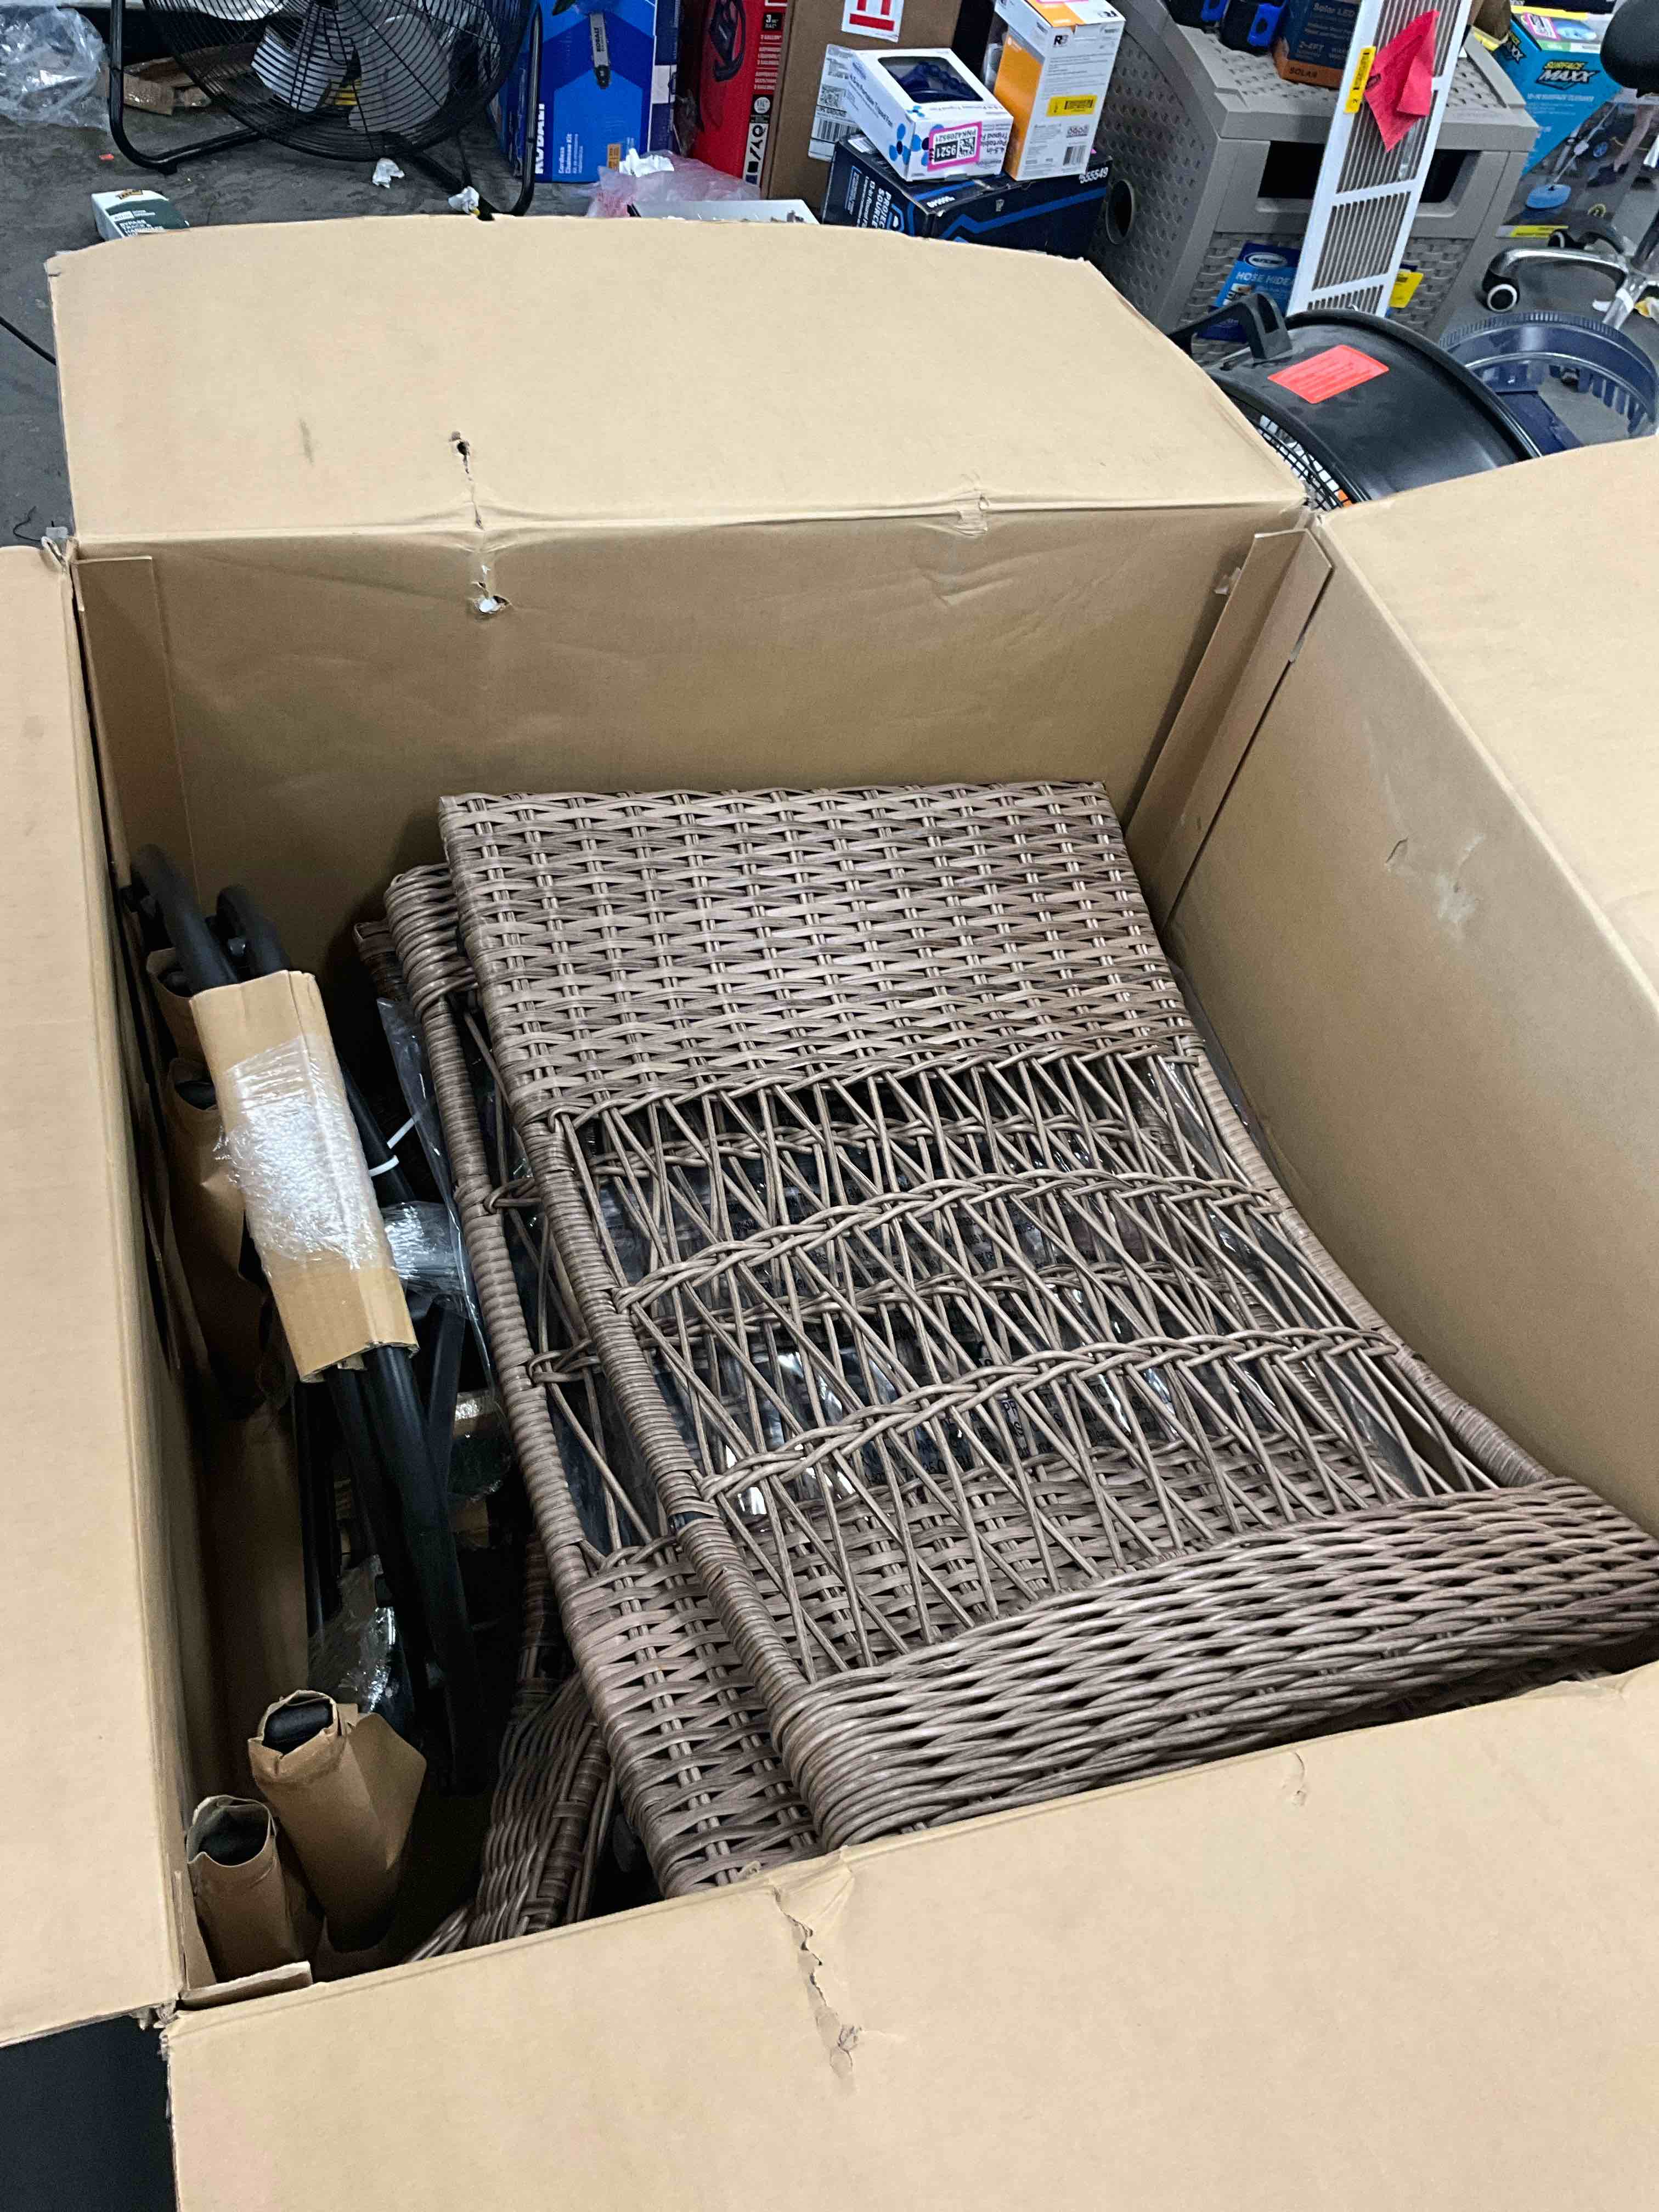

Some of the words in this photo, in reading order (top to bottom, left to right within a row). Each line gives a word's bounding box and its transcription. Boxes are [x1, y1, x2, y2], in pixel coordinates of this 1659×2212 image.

[1539, 69, 1595, 82] MAXX
[936, 145, 956, 157] 9521
[871, 188, 885, 228] SOURCE
[878, 190, 892, 228] PROJEC
[1235, 272, 1265, 282] HOSE
